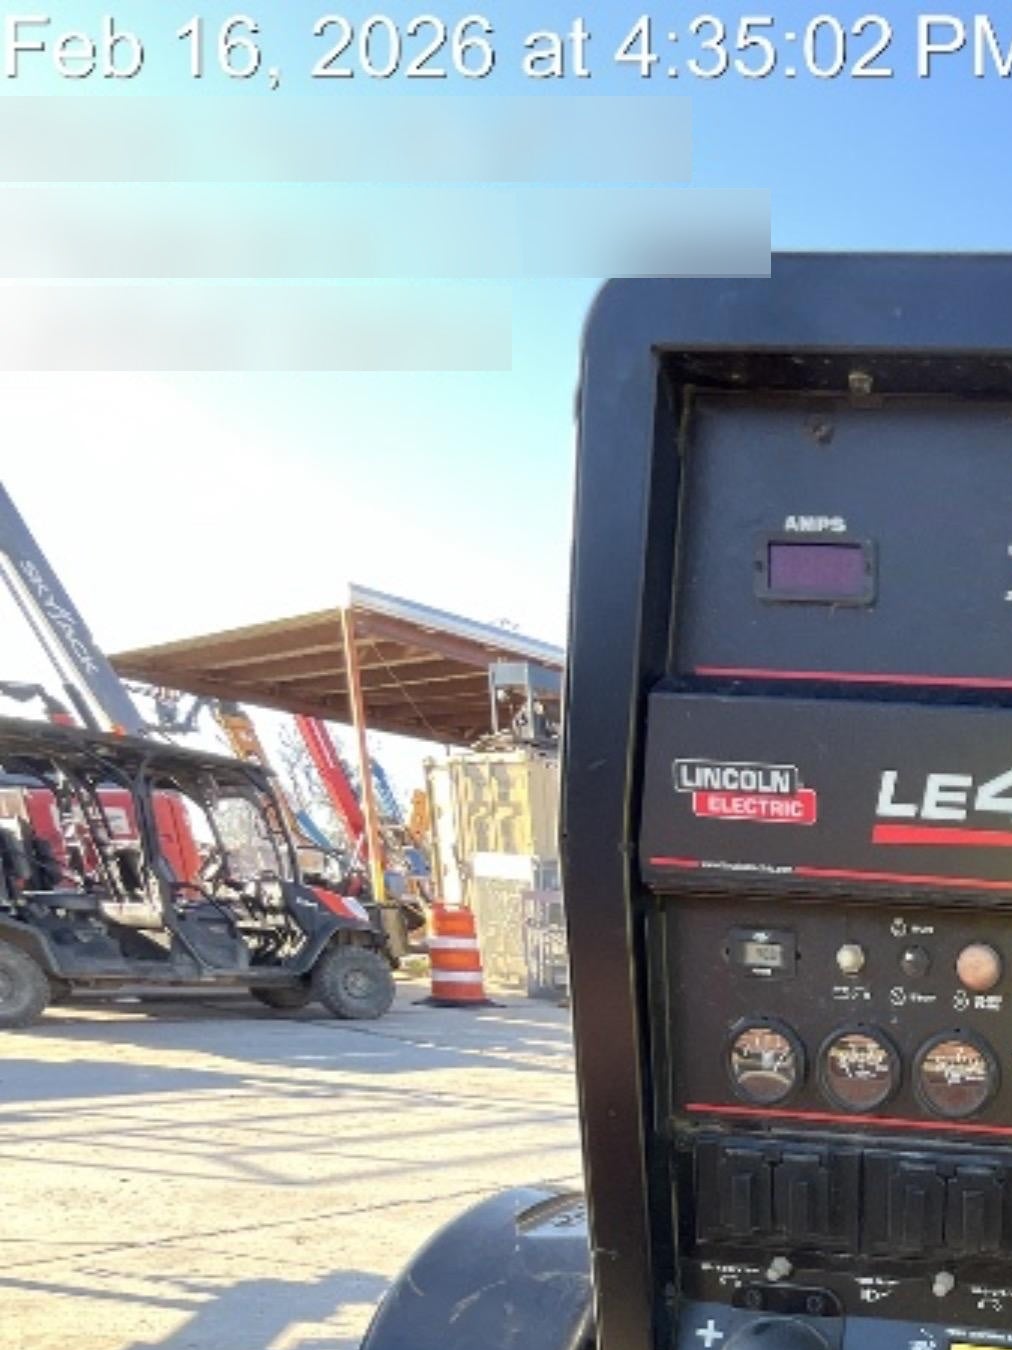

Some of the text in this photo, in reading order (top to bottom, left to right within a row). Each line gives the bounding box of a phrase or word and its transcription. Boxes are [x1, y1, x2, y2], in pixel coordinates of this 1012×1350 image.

[785, 514, 847, 532] AMPS
[20, 558, 99, 675] SKYJACK
[680, 764, 790, 793] LINCOLN
[706, 795, 805, 817] ELECTRIC
